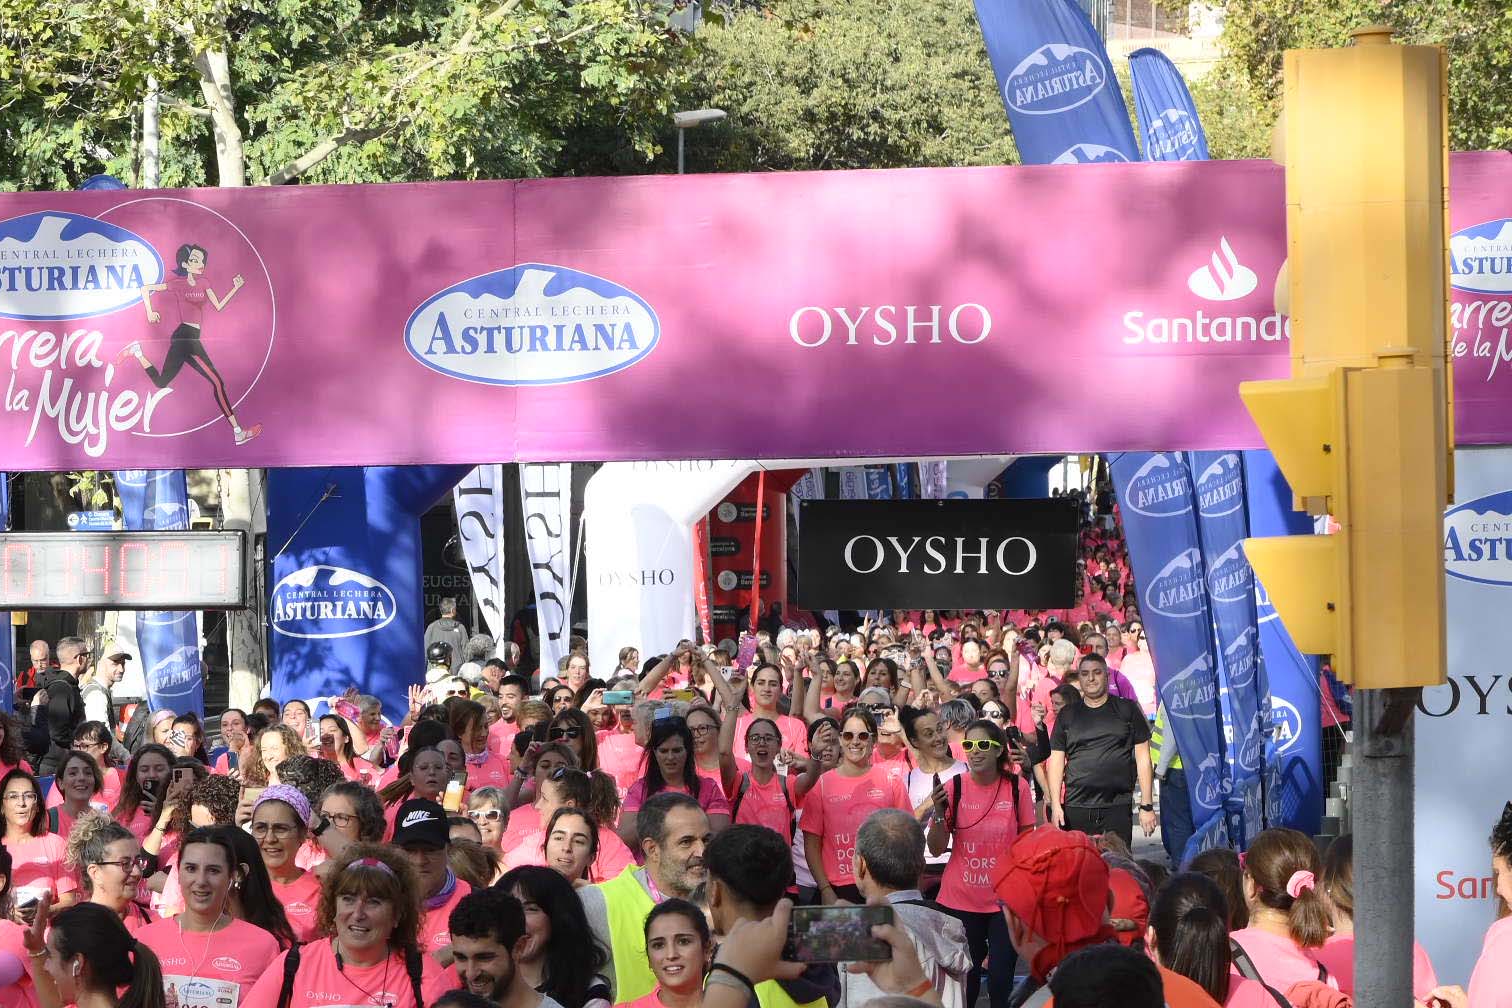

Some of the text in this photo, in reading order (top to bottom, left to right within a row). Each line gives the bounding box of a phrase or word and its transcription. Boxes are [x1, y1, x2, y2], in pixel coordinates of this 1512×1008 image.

[67, 248, 139, 260] LECHERA
[463, 305, 631, 320] CENTRAL LECHERA
[788, 303, 992, 347] OYSHO
[424, 311, 640, 355] ASTURIANA
[5, 373, 29, 411] la
[24, 364, 173, 458] Mujer
[844, 534, 1037, 577] OYSHO
[287, 590, 382, 599] CENTRAL LECHERA
[274, 595, 387, 622] ASTURIANA
[407, 810, 431, 824] NIKE
